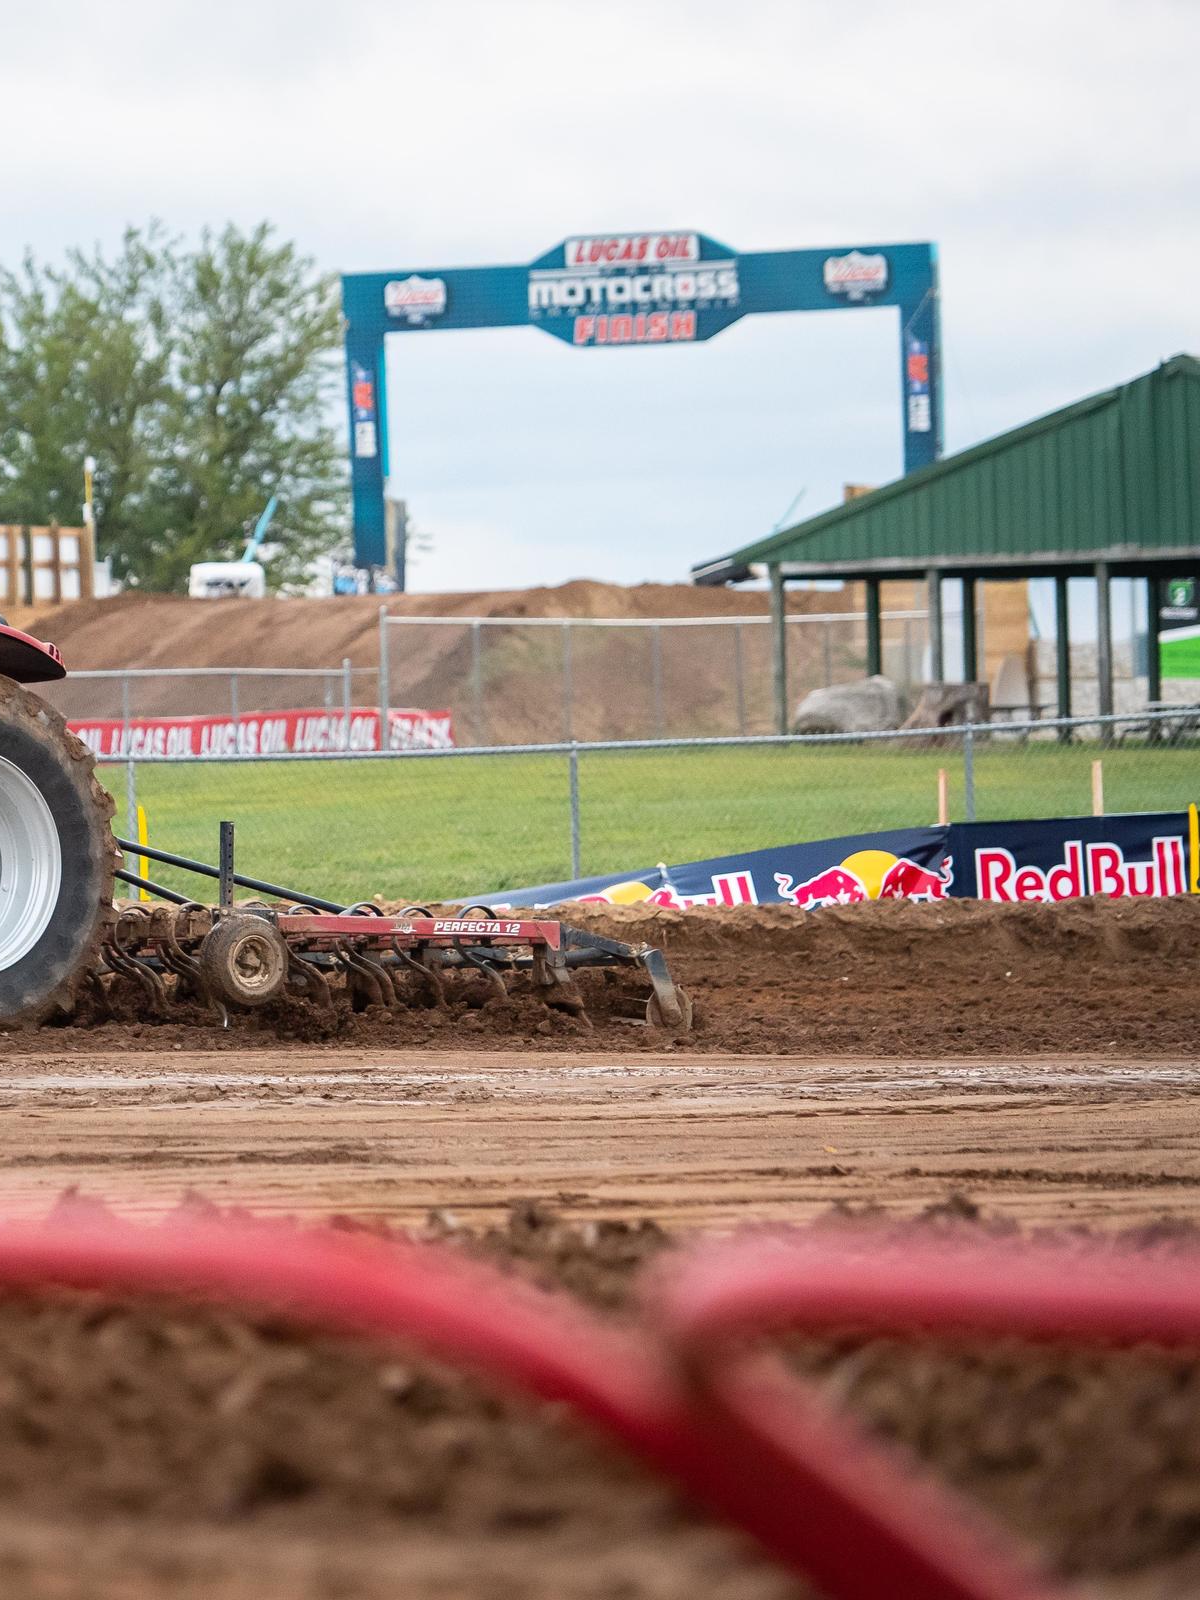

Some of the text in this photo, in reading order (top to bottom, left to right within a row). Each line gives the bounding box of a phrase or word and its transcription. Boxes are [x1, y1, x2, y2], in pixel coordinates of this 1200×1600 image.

[574, 234, 691, 264] LUCAS OIL
[528, 271, 740, 307] MOTOCROSS
[573, 311, 697, 345] FINISH
[433, 921, 521, 934] PERFECTA 12
